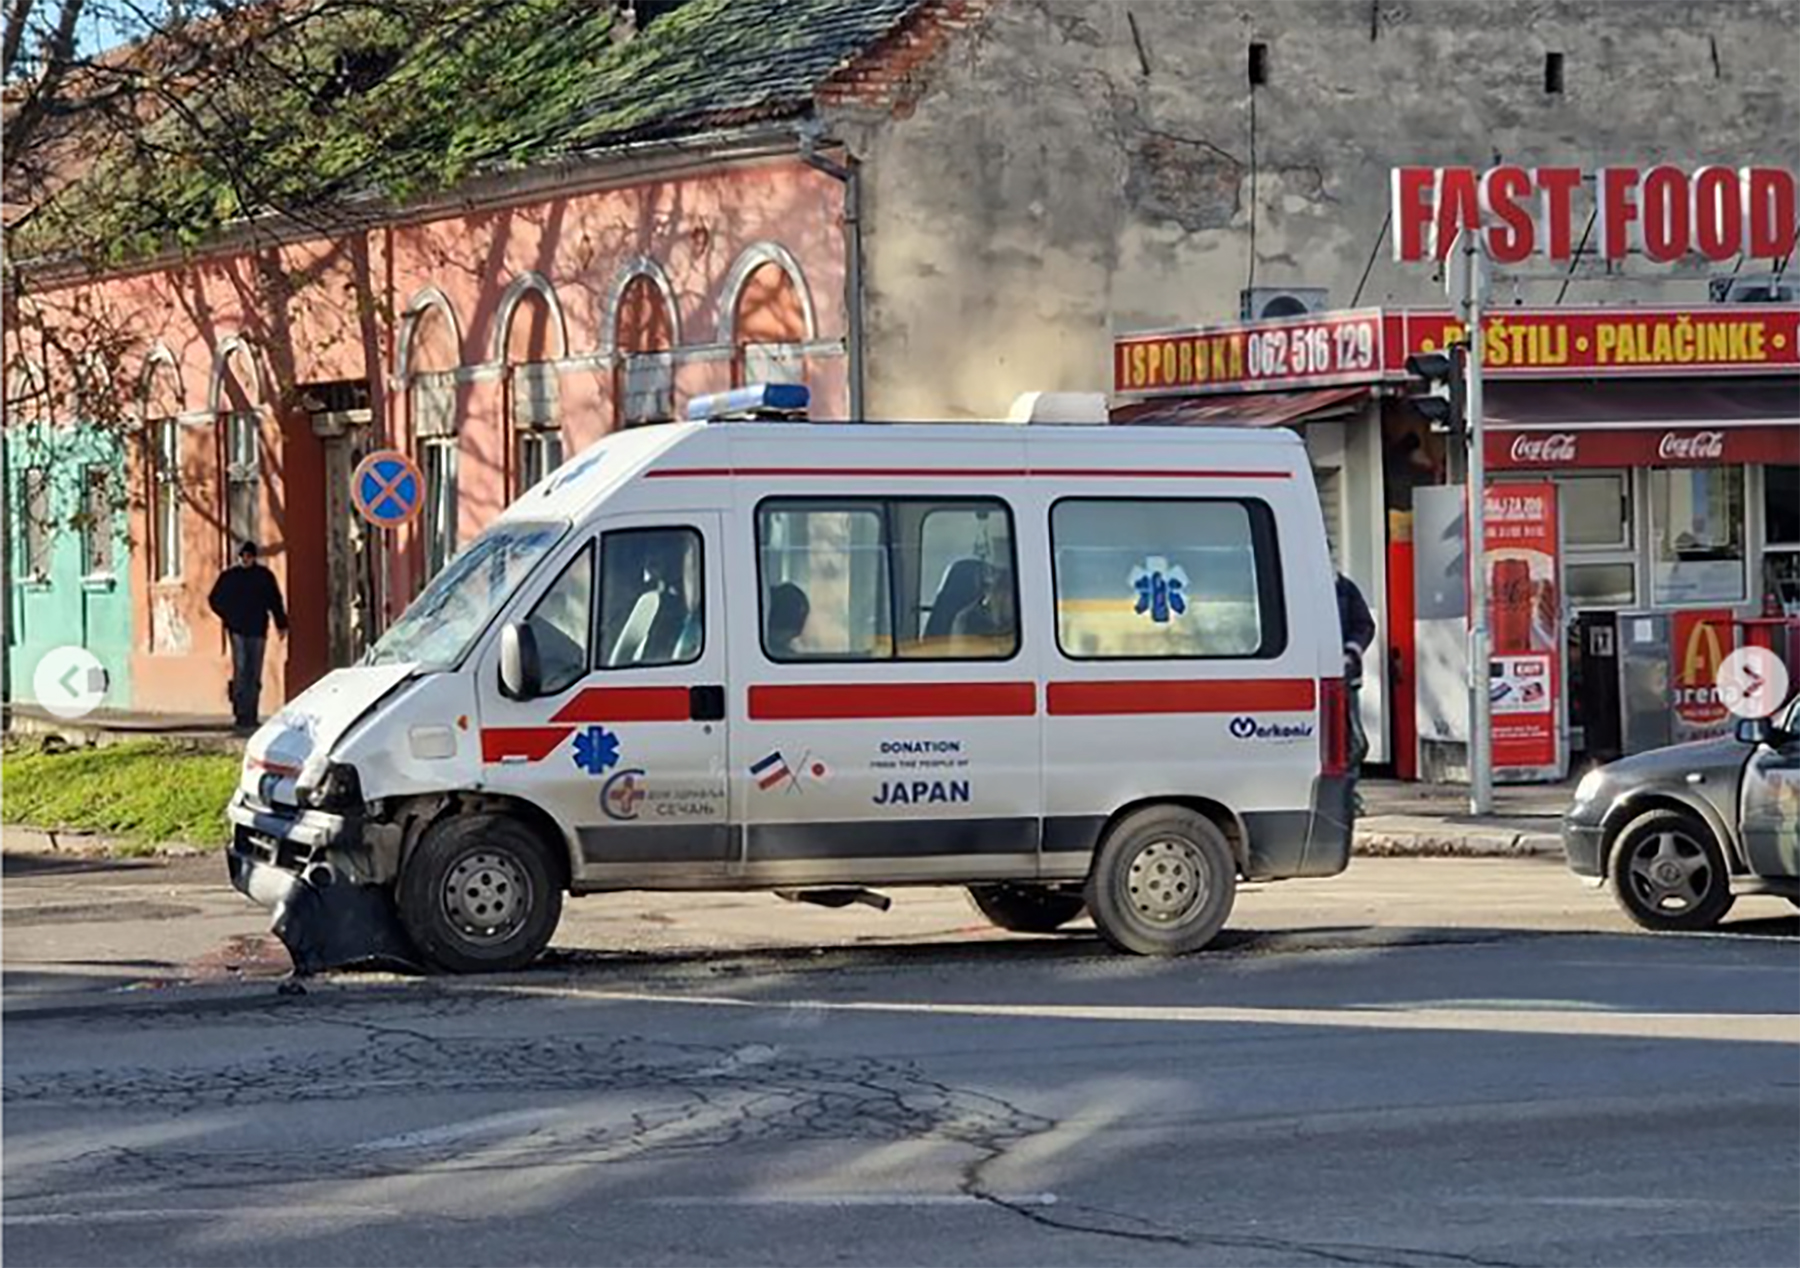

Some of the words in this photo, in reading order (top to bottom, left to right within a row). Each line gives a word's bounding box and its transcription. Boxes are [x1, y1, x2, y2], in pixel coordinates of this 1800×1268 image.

[1392, 166, 1581, 262] FAST
[1602, 165, 1795, 263] FOOD
[1123, 336, 1243, 386] ISPORUKA
[1248, 332, 1288, 377] 062
[1291, 327, 1330, 373] 516
[1333, 322, 1372, 370] 129
[1598, 315, 1766, 363] PALAČINKE
[880, 741, 960, 753] DONATION
[899, 760, 917, 768] THE
[919, 759, 954, 767] PEOPLE
[872, 781, 970, 805] JAPAN
